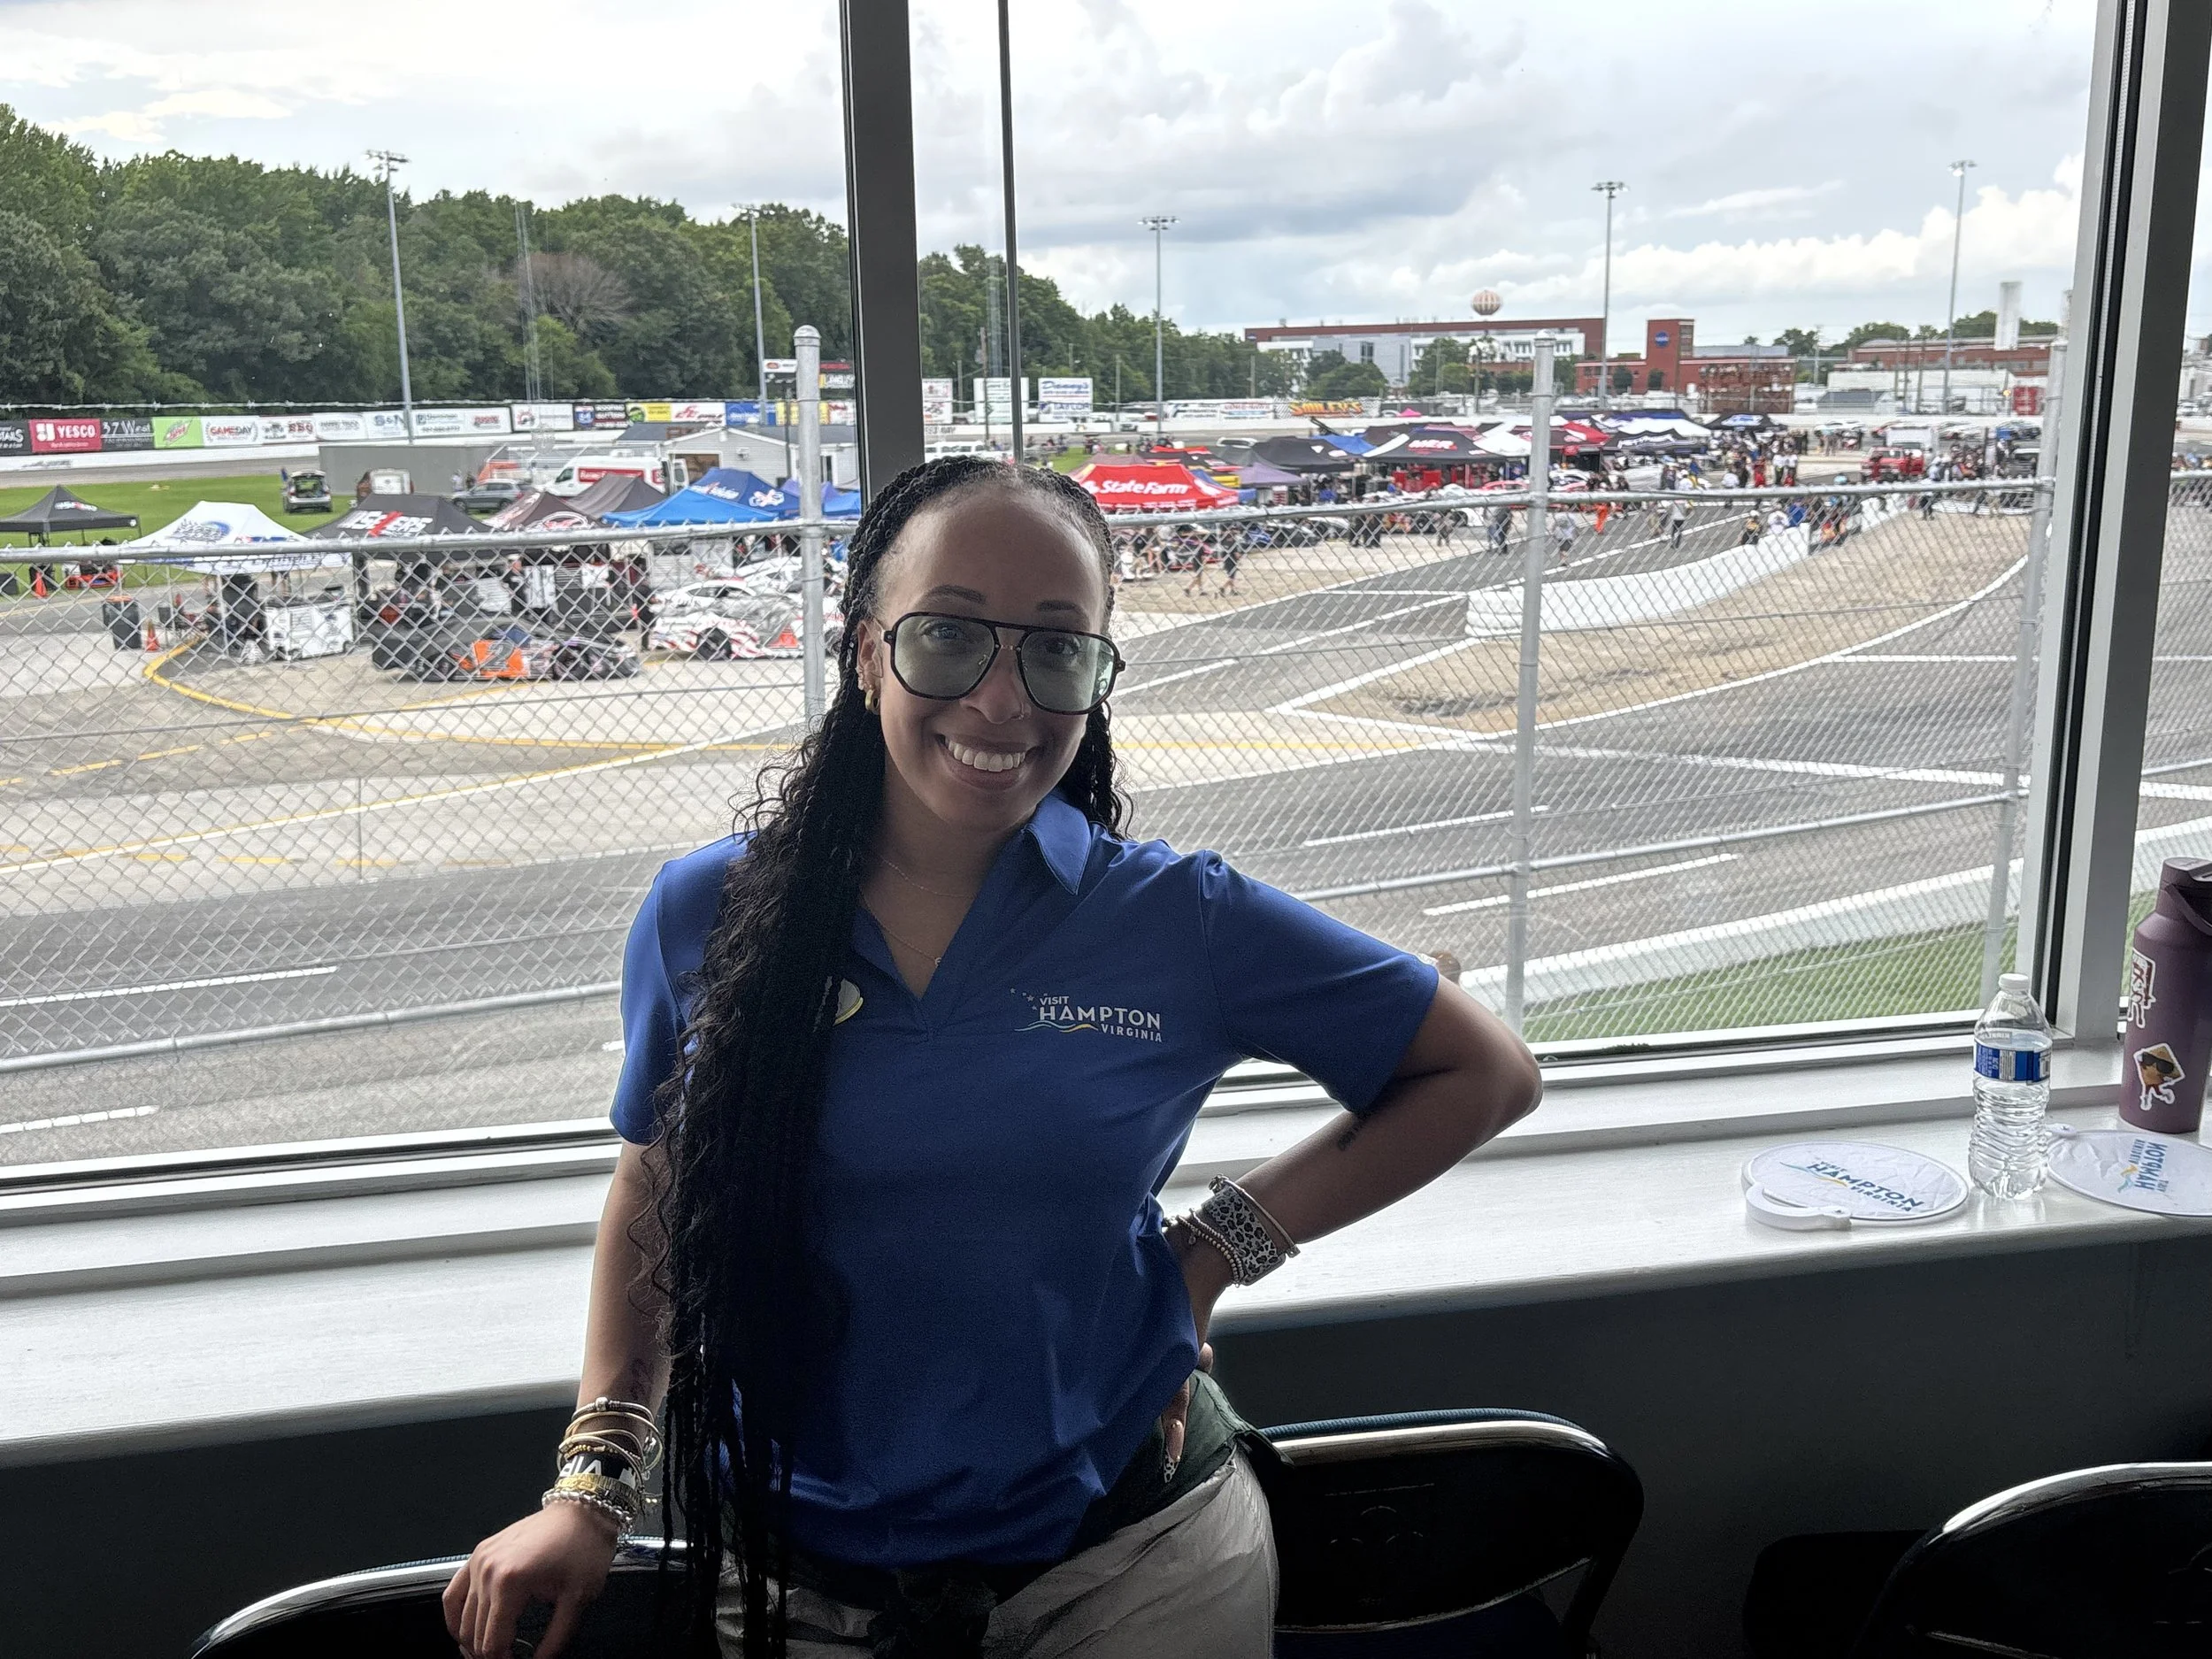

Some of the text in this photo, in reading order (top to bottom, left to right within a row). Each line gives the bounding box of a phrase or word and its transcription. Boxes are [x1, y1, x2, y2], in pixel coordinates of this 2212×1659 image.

[57, 424, 96, 439] YESCO
[210, 425, 252, 434] GAMEDAY
[1039, 995, 1069, 1005] VISIT
[1039, 1006, 1161, 1030] HAMPTON
[1101, 1024, 1163, 1042] VIRGINIA
[1807, 1164, 1924, 1208] HAMPTON
[1850, 1186, 1912, 1211] VIRGINIA
